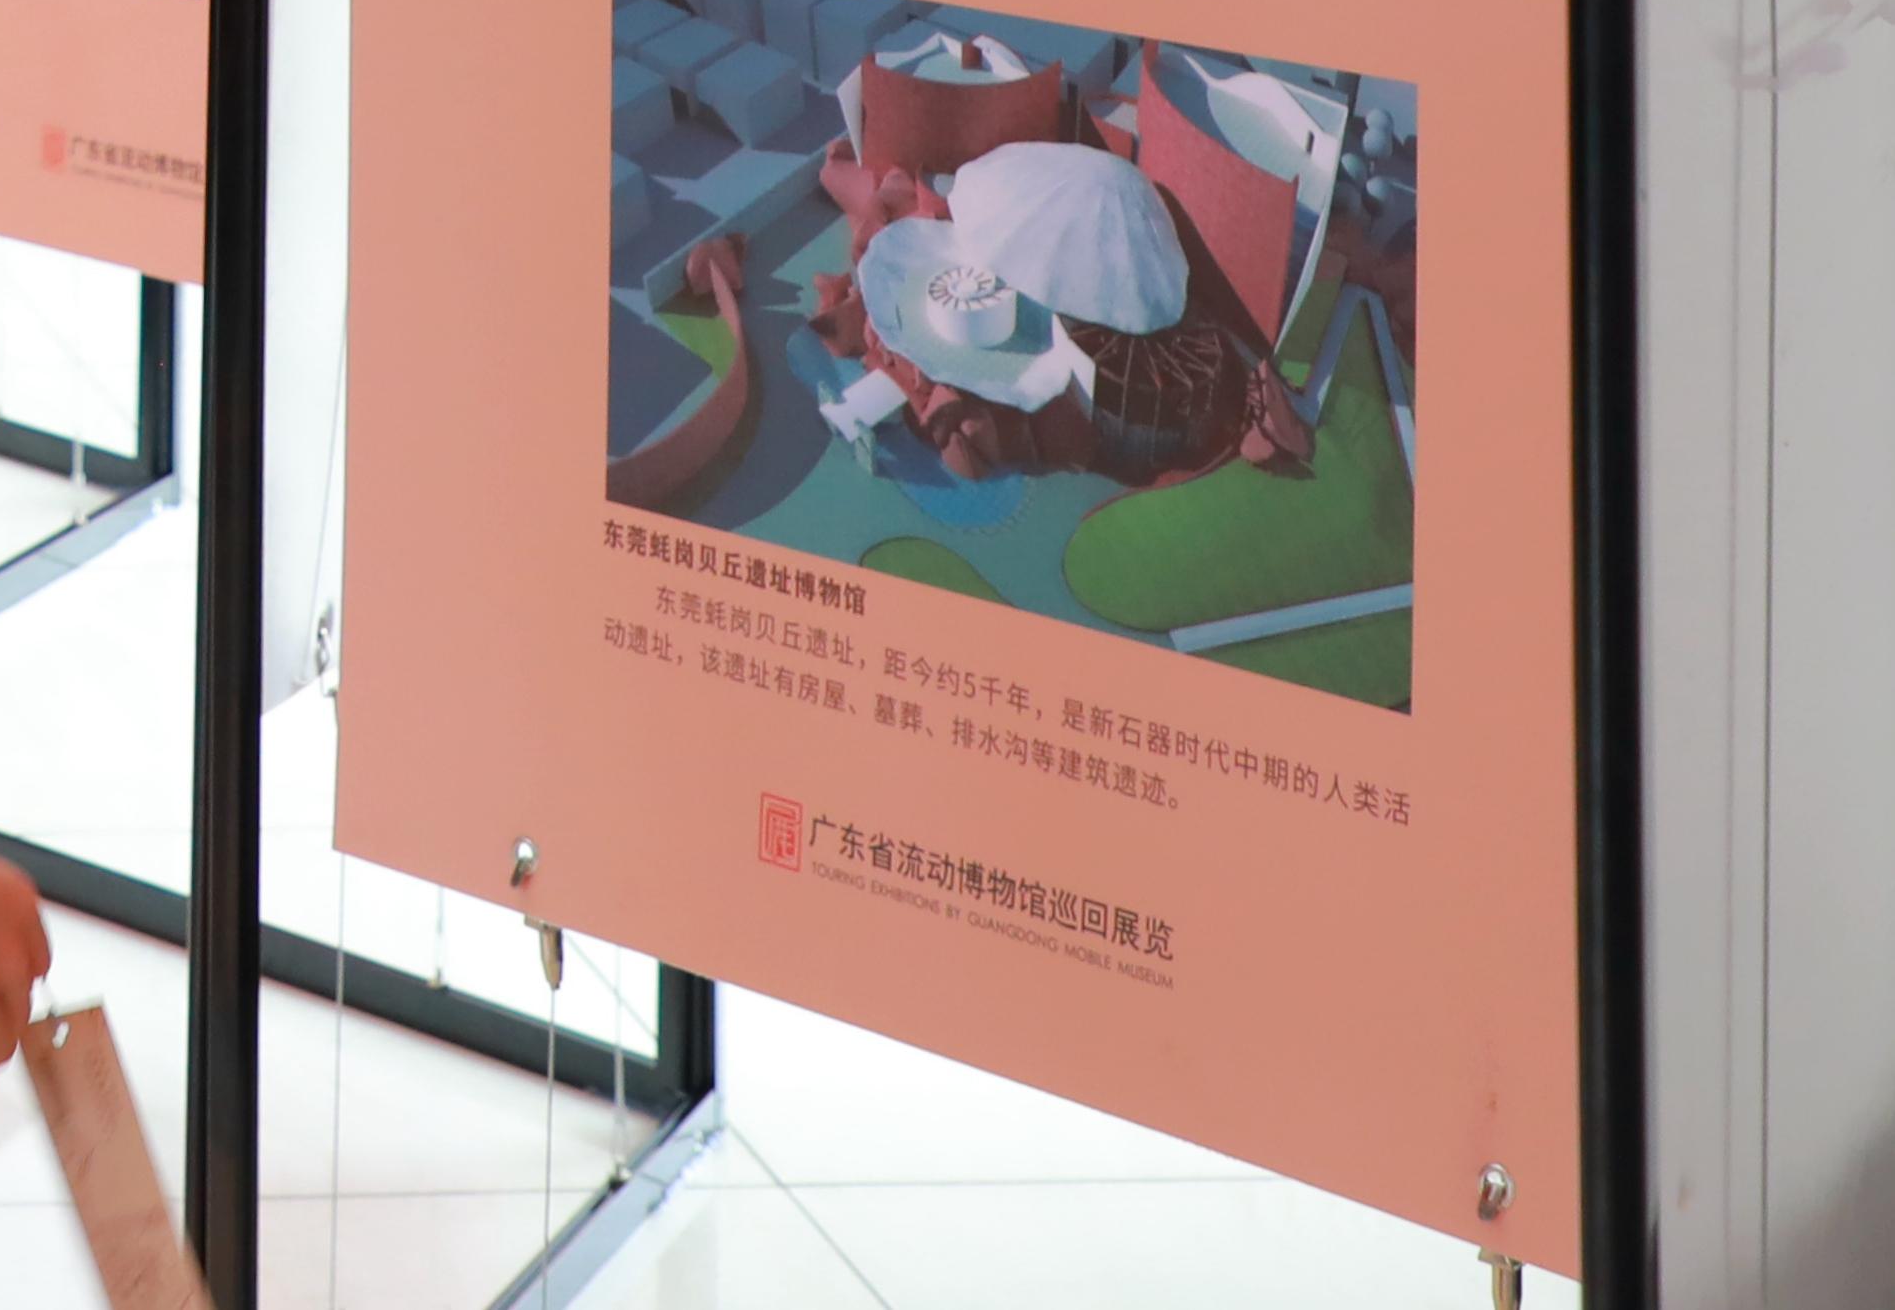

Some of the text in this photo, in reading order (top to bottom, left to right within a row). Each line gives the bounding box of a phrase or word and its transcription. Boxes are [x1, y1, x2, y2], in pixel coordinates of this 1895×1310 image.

[603, 519, 867, 616] 东莞蚝岗贝丘遗址博物馆
[808, 814, 1174, 961] 广东省流动博物馆巡回展览
